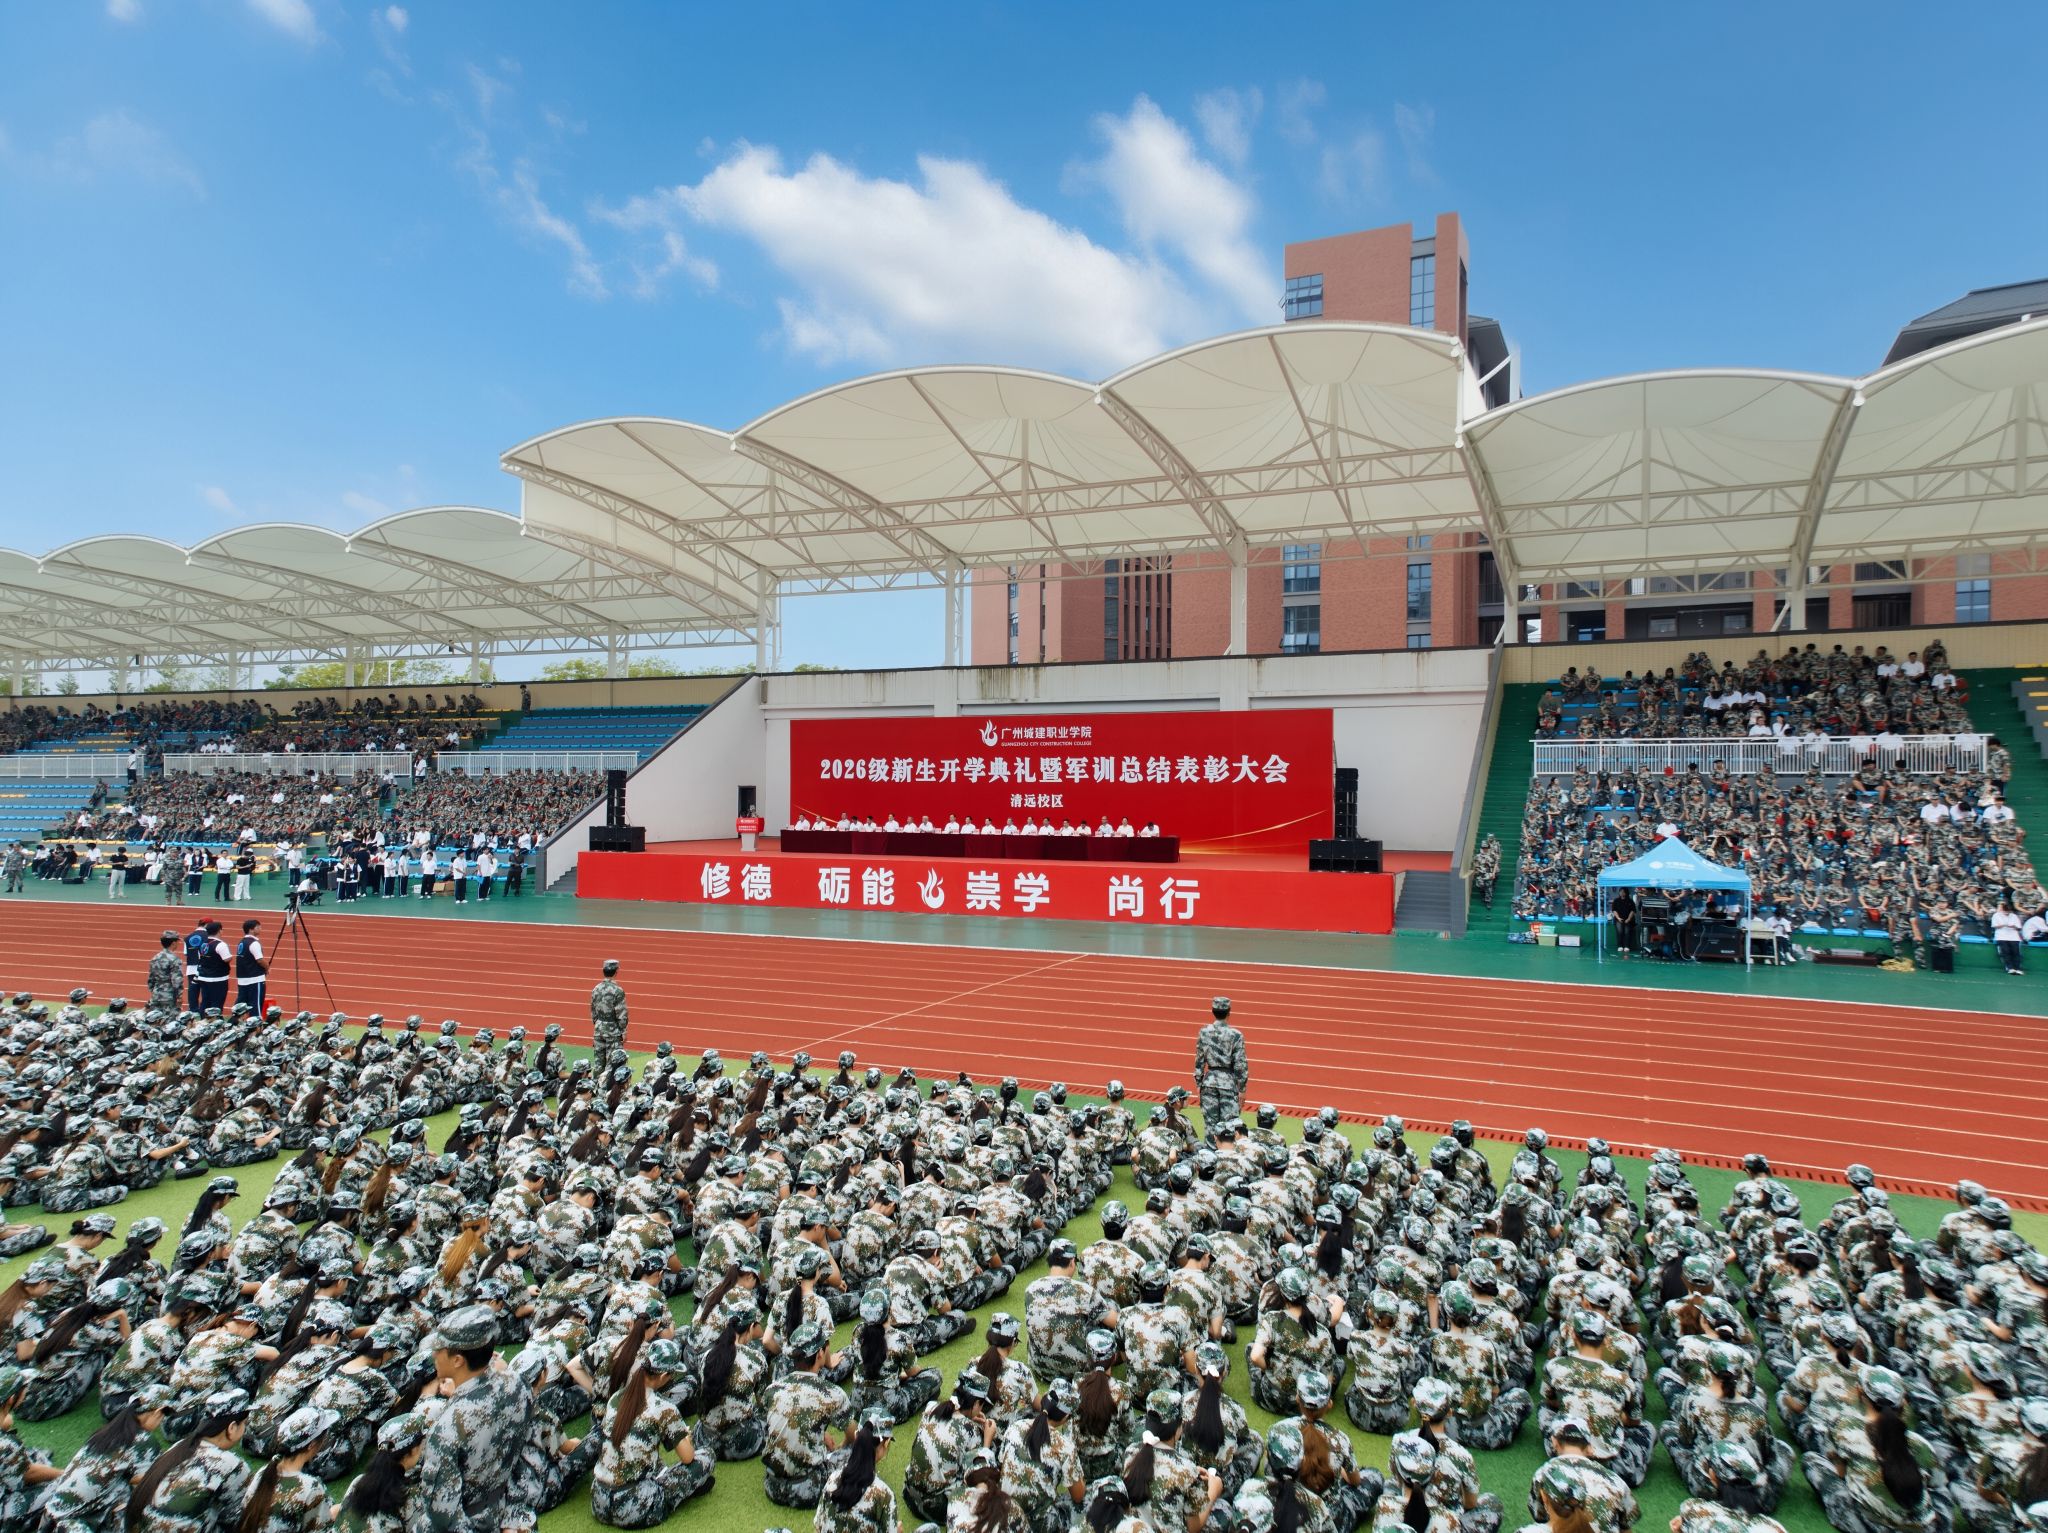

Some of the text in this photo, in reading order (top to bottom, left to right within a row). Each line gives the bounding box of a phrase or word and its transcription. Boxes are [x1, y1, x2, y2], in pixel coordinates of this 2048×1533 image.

[1001, 726, 1092, 739] 广州城建职业学院
[820, 754, 1290, 784] 2026级新生开学典礼暨军训总结表彰大会
[1010, 793, 1064, 808] 清远校区
[700, 862, 1201, 920] 修德 砺能 崇学 尚行
